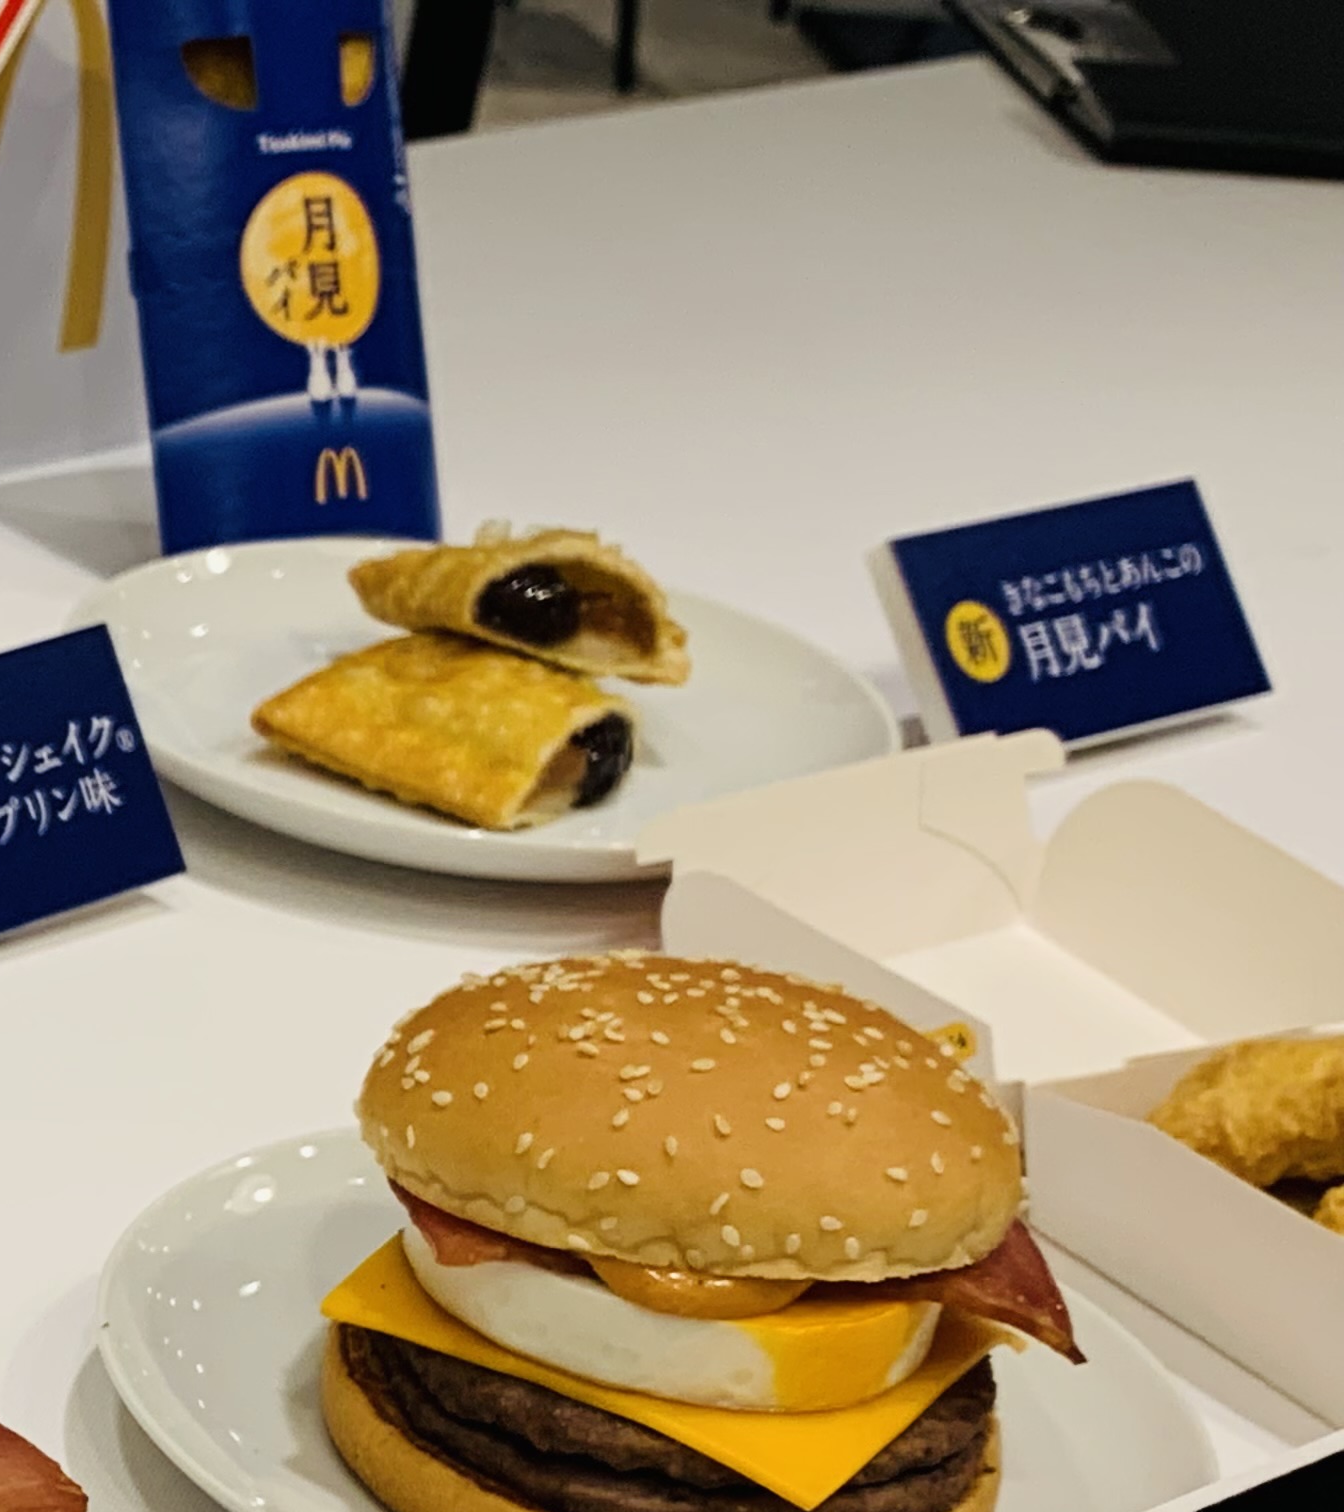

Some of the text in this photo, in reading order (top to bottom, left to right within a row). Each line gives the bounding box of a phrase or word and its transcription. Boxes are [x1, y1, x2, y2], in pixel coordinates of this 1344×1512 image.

[265, 259, 298, 322] パイ
[303, 195, 348, 321] 月見
[957, 613, 999, 666] 新
[1019, 602, 1160, 683] 月見パイ
